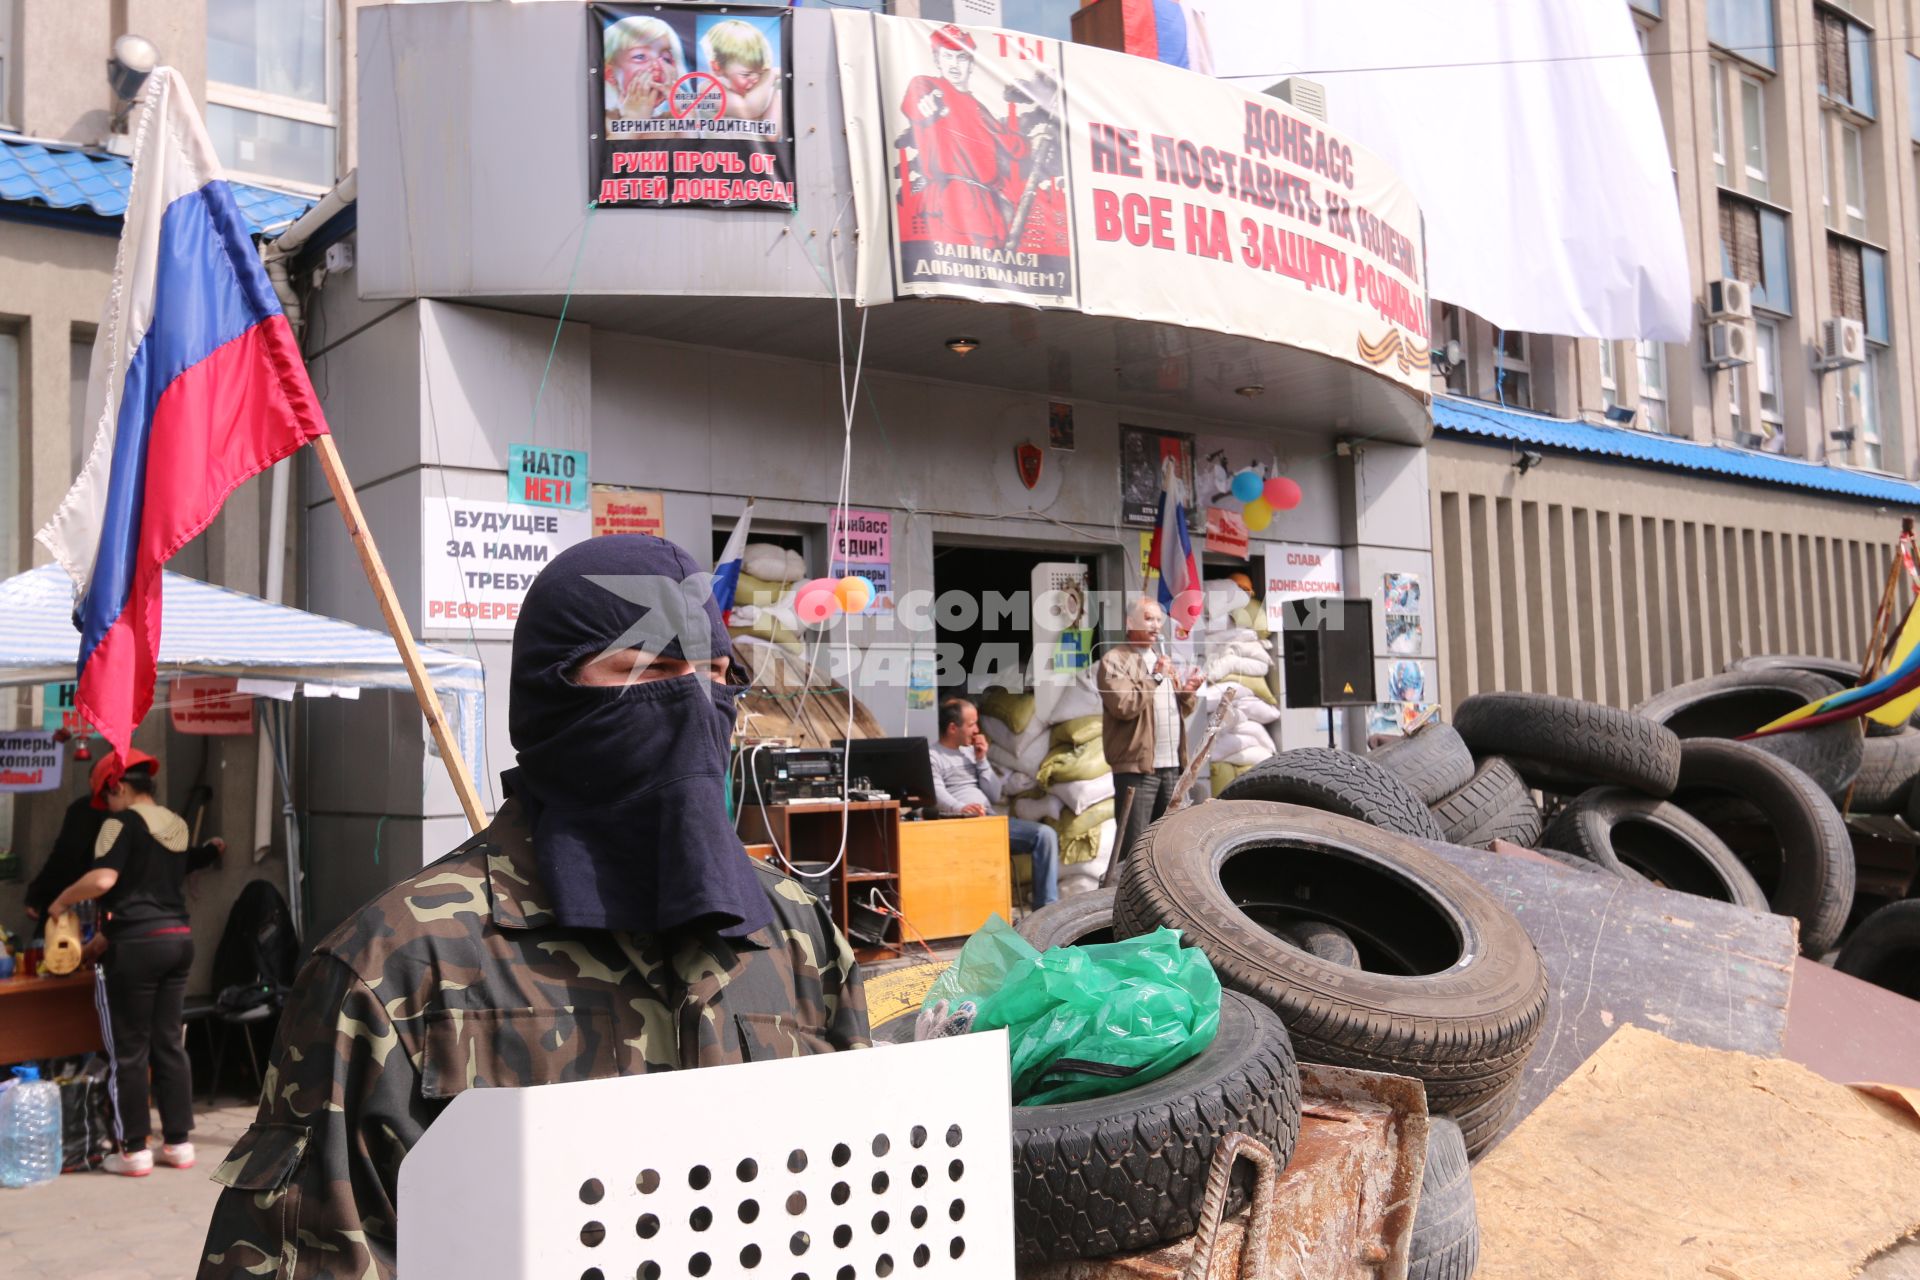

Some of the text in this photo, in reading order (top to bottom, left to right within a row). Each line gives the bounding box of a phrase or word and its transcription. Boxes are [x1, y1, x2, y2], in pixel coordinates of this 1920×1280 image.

[992, 33, 1045, 63] ТЫ
[611, 120, 776, 135] ВЕРНИТЕ НАМ РОДИТЕЛЕЙ!
[1244, 100, 1354, 190] ДОНБАСС
[612, 152, 776, 175] РУКИ ПРОЧЬ ОТ
[599, 176, 795, 203] ДЕТЕЙ ДОНБАССА!
[1088, 122, 1143, 179] НЕ
[1151, 133, 1322, 227] ПОСТАВИТЬ
[1325, 189, 1356, 244] НА
[934, 240, 1039, 268] ЗАПИСАЛСЯ
[1092, 188, 1176, 251] ВСЕ
[1184, 202, 1233, 263] НА
[1240, 217, 1348, 296] ЗАЩИТУ
[522, 450, 576, 478] НАТО
[524, 477, 571, 504] НЕТ!
[453, 510, 558, 535] БУДУЩЕЕ
[446, 540, 549, 562] ЗА НАМИ
[838, 538, 884, 557] един!
[1287, 553, 1322, 566] СЛАВА
[835, 568, 886, 581] шхтеры
[1269, 579, 1341, 592] ДОНБАССКИМ
[428, 600, 522, 621] РЕФЕРЕ
[0, 738, 56, 753] хтеры
